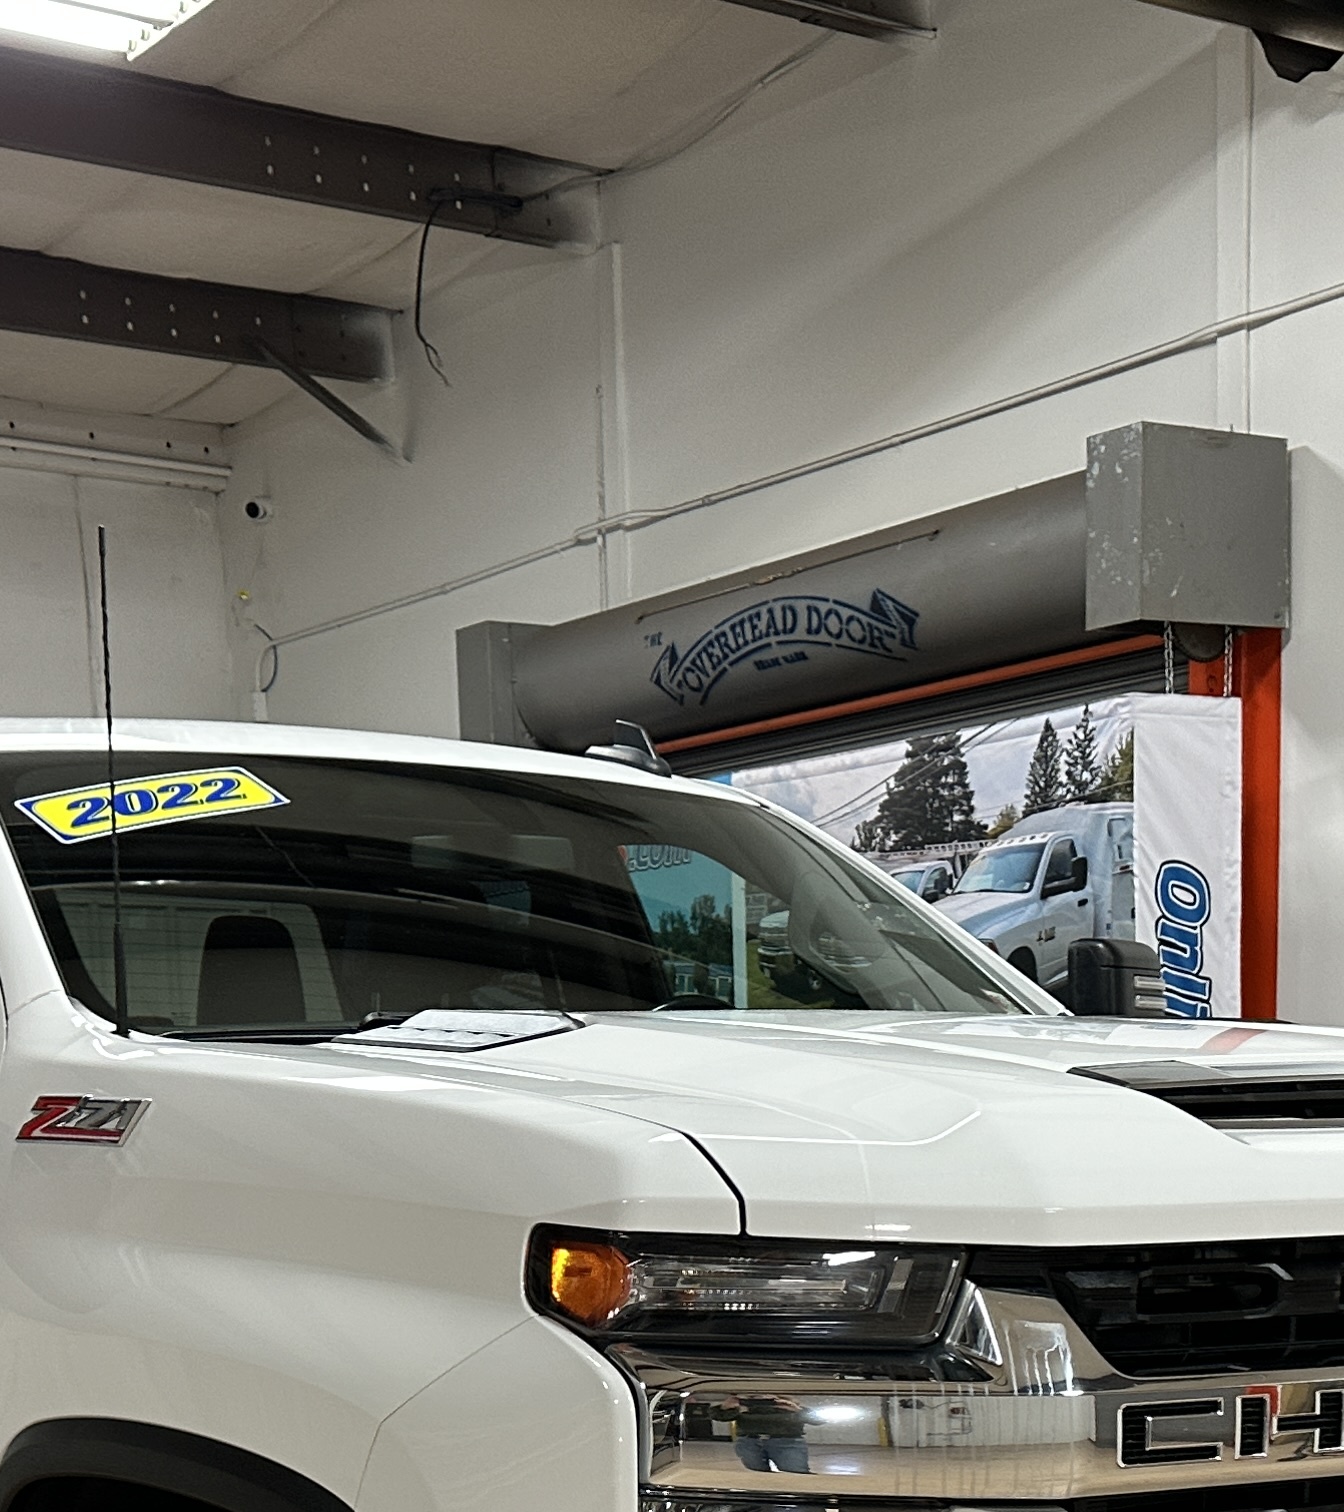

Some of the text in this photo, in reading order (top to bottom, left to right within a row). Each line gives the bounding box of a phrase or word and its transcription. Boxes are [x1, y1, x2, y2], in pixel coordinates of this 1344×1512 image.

[682, 604, 893, 693] OVERHEAD DOOR
[66, 778, 247, 829] 2022
[16, 1094, 152, 1147] Z71
